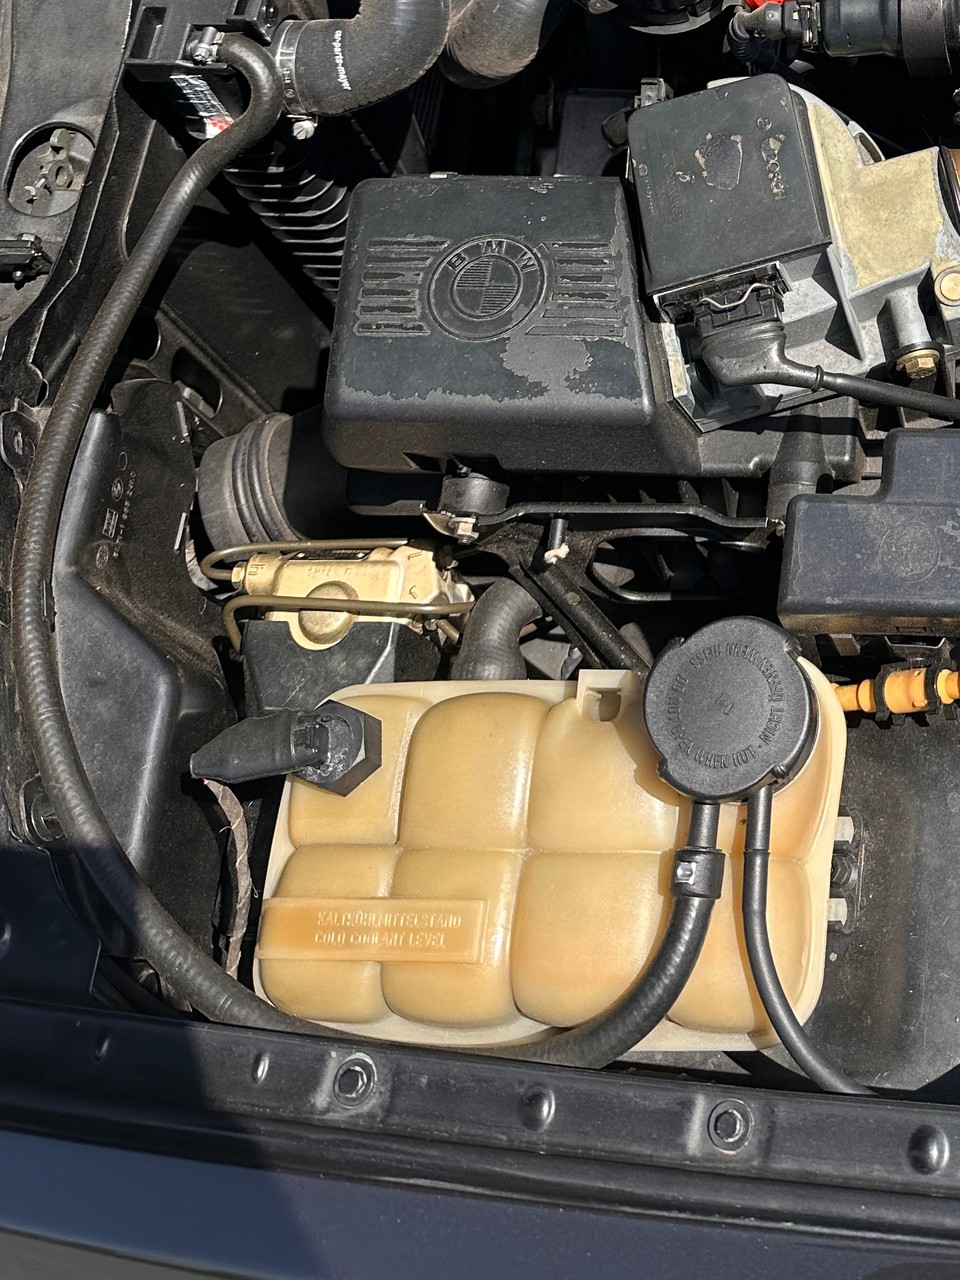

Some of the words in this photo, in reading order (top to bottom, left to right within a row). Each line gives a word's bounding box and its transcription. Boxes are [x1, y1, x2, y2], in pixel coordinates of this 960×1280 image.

[446, 238, 540, 274] BMW
[688, 643, 723, 669] HEISS
[725, 642, 761, 664] WENN
[758, 706, 786, 746] NICHT
[694, 745, 729, 769] WHEN
[731, 744, 757, 767] HOT
[349, 931, 406, 948] COOLANT
[408, 932, 447, 949] LEVEL
